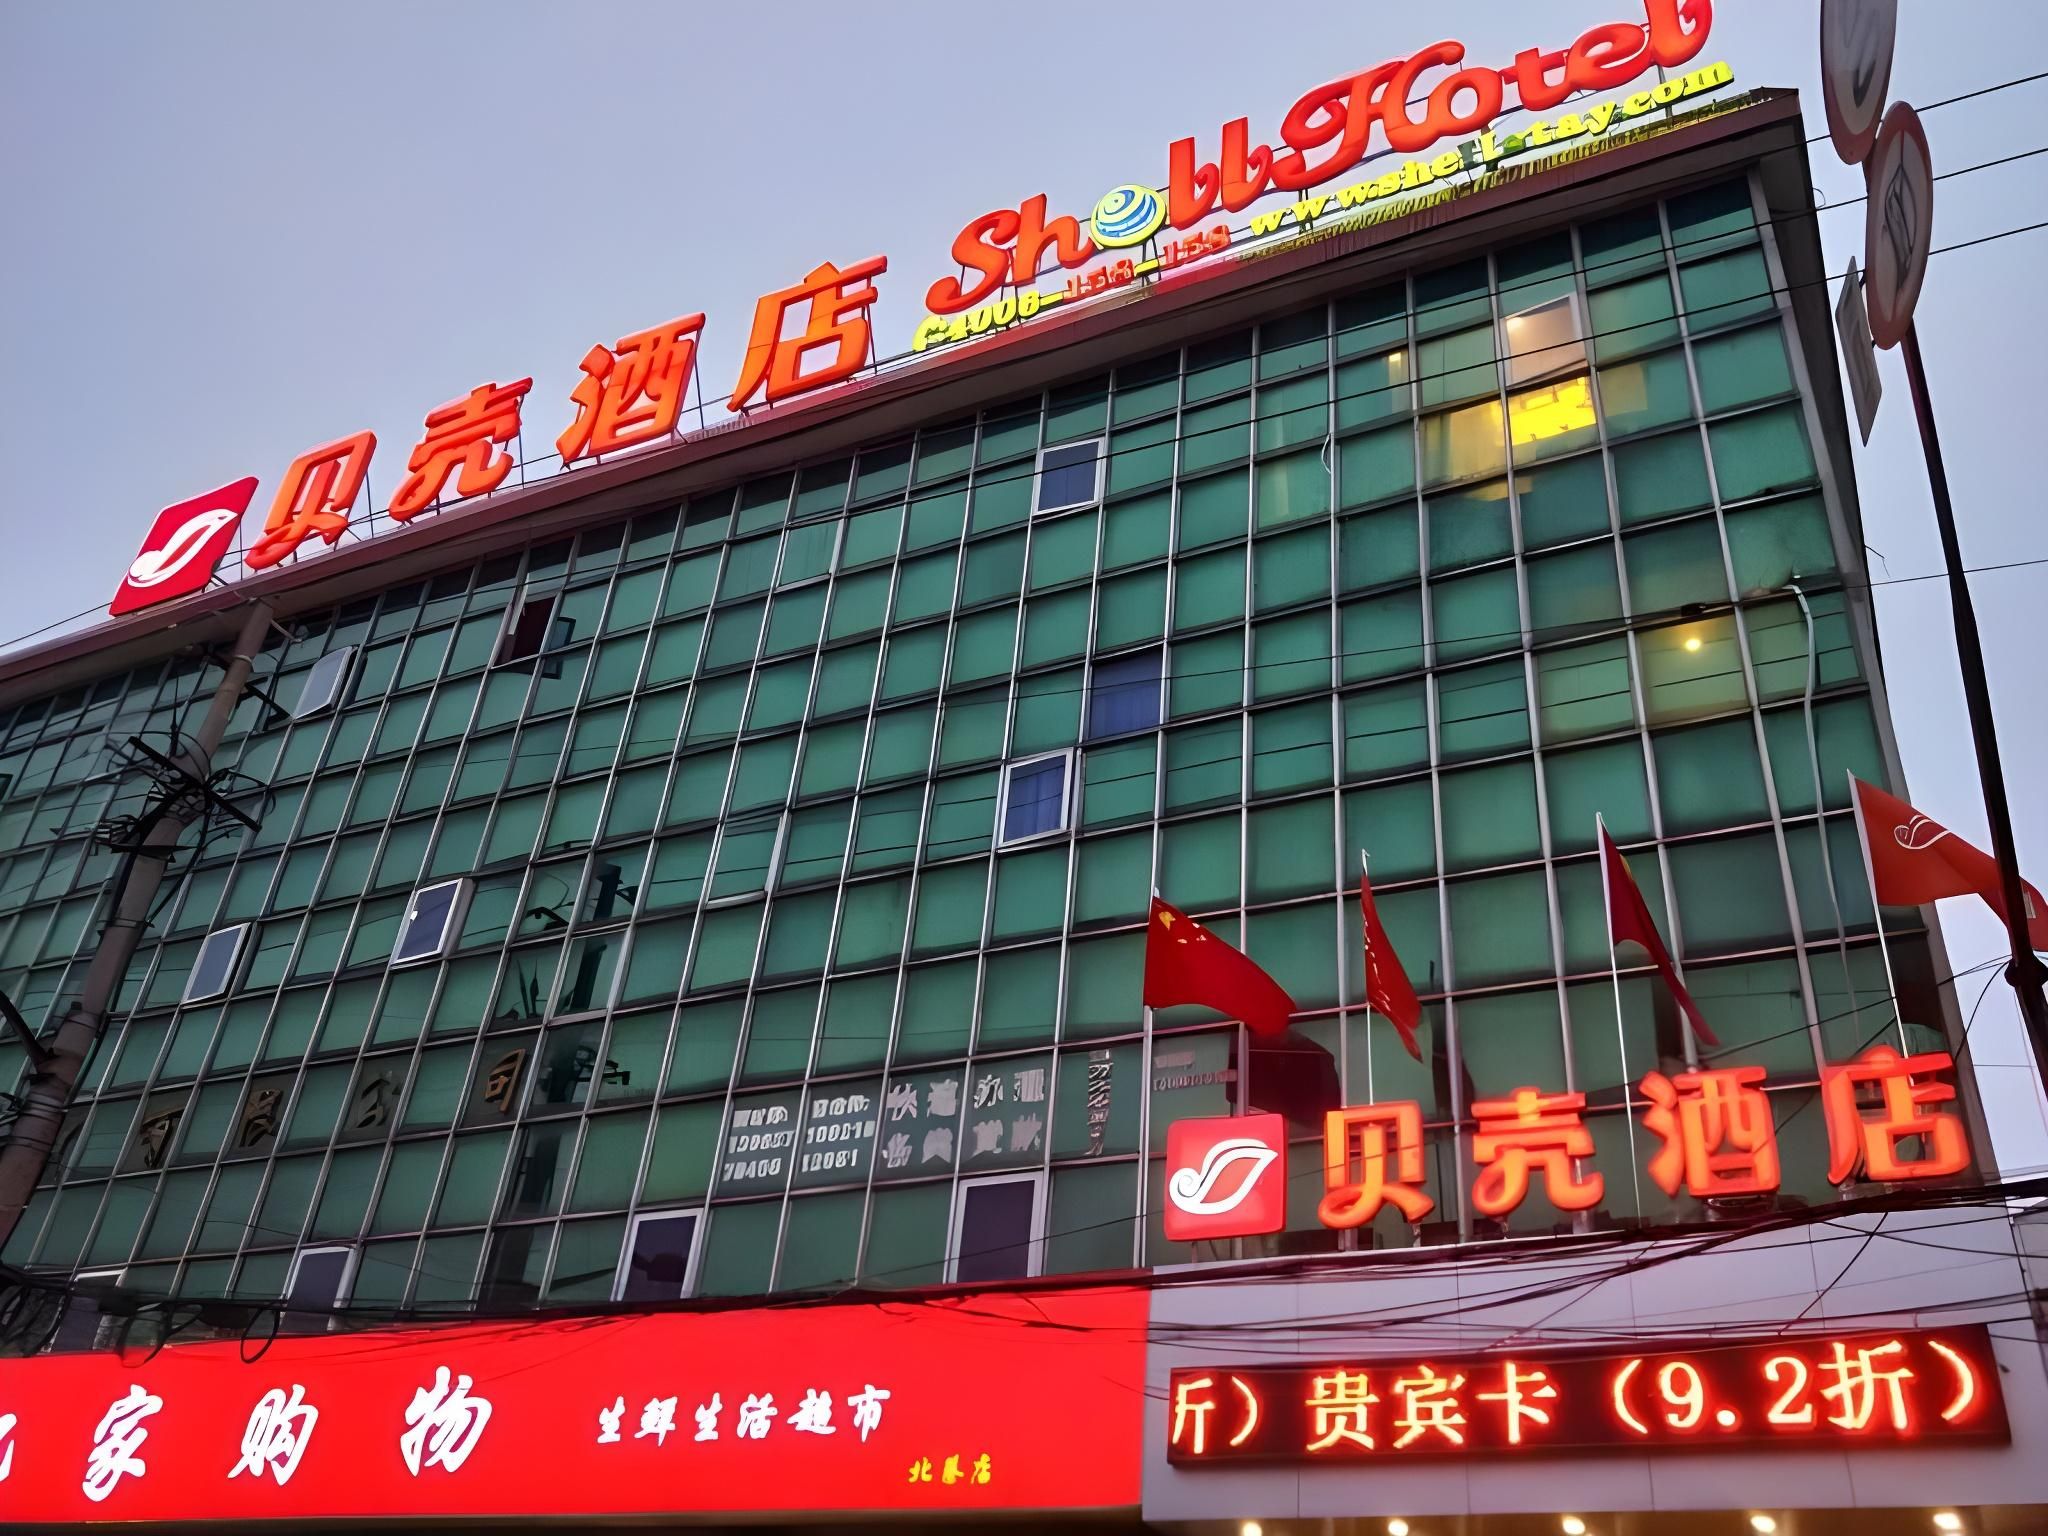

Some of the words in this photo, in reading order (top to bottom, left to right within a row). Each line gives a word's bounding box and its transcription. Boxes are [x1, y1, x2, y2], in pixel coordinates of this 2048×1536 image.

[244, 255, 888, 570] 贝壳酒店
[1318, 1046, 1972, 1229] 贝壳酒店
[0, 1366, 493, 1502] 家购物
[597, 1384, 891, 1447] 生鲜生活超市
